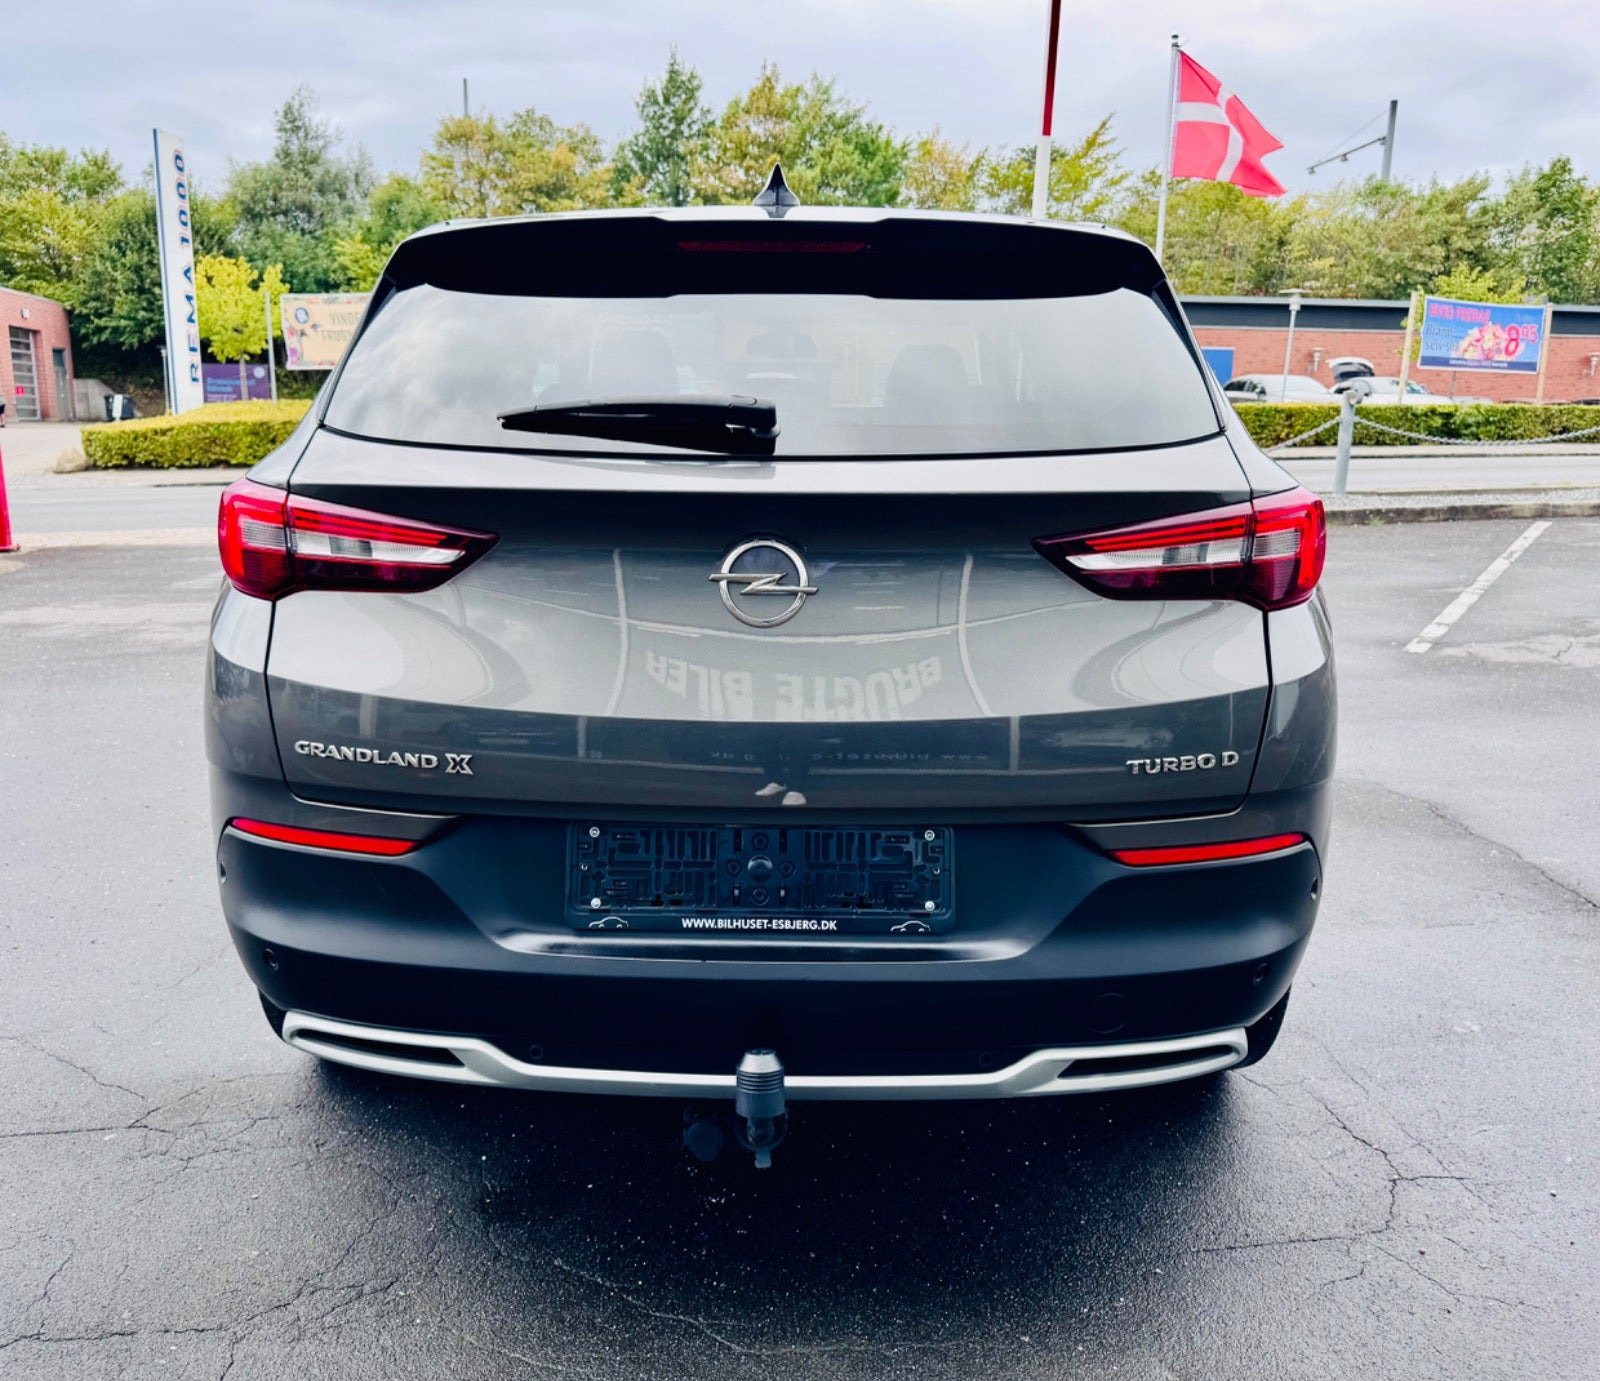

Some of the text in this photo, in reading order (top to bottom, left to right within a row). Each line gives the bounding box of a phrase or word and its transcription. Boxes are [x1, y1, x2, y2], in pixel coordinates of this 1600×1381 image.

[173, 148, 200, 383] REMA 1000
[294, 739, 474, 775] GRANDLAND X
[1126, 751, 1239, 775] TURBO D
[681, 917, 838, 931] WWW.BILHUSET-ESBJERG.DK
